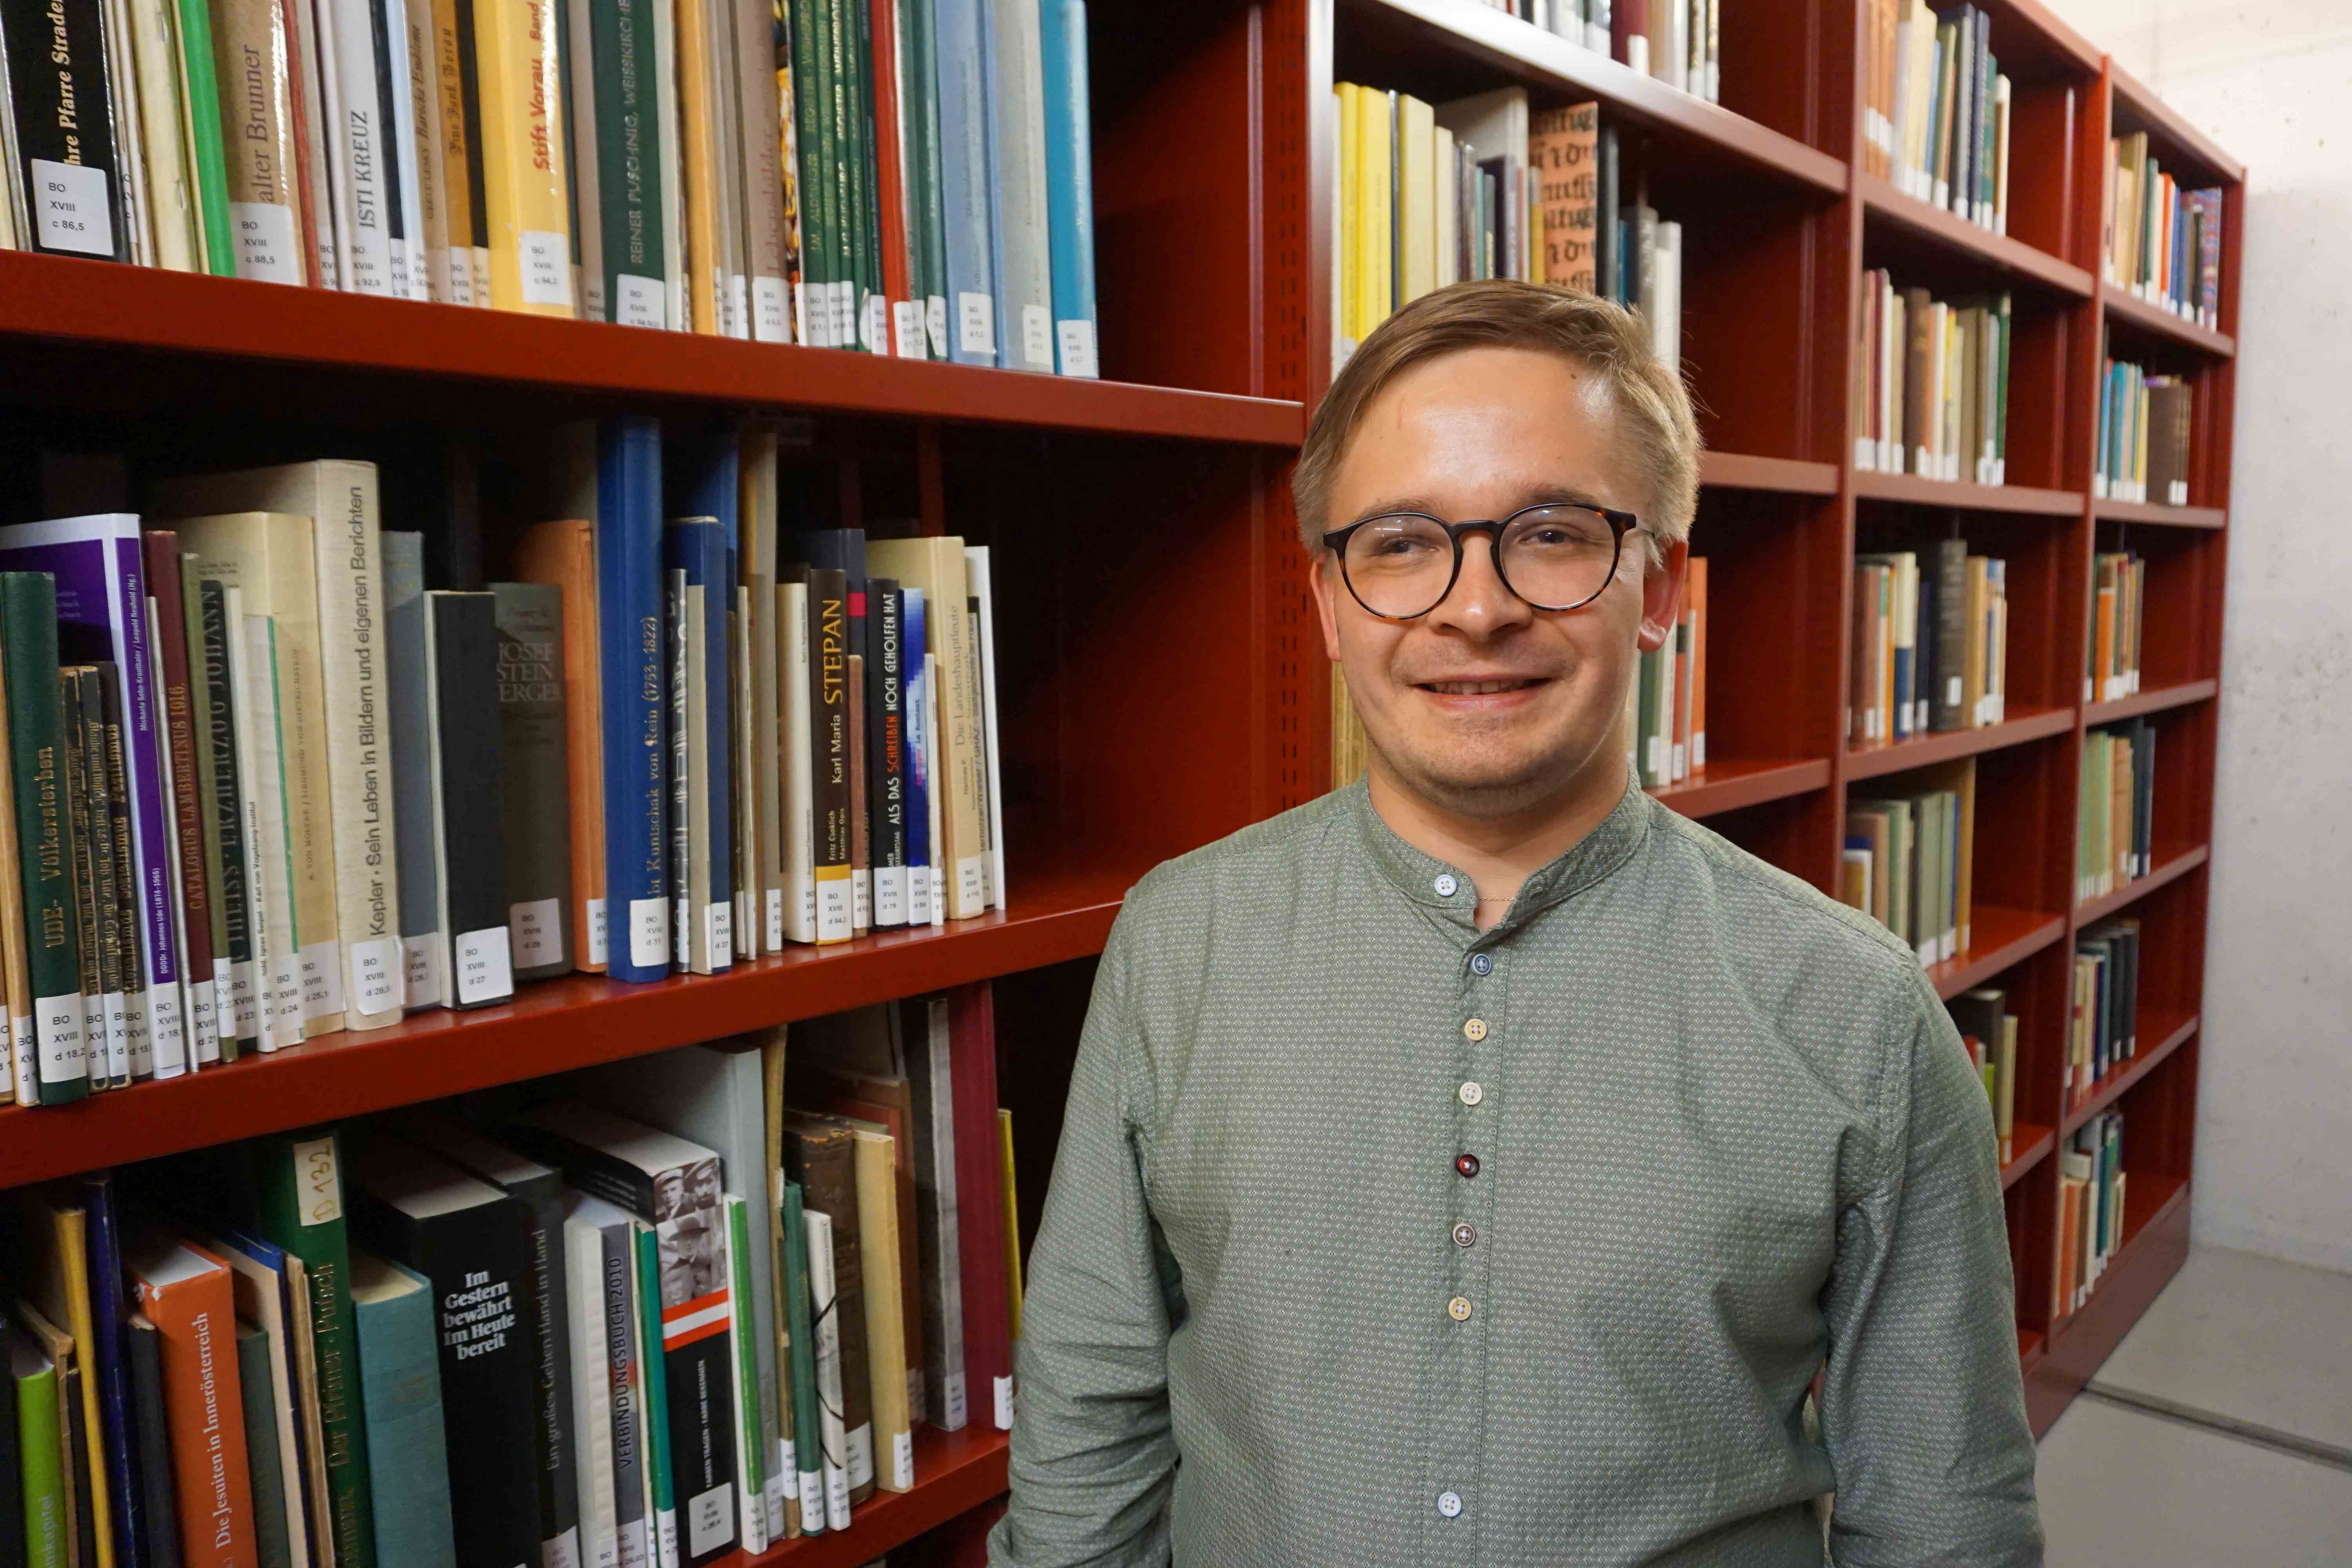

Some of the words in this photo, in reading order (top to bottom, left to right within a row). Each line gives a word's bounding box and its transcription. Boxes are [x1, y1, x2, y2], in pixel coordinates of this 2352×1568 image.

[46, 0, 69, 65] Strade
[527, 1, 541, 41] Band
[59, 71, 79, 130] Pfarre
[244, 45, 268, 143] Brunner
[528, 58, 546, 116] Vorau
[350, 111, 373, 183] KREUZ
[530, 123, 550, 171] Stift
[49, 182, 66, 192] BO
[50, 200, 76, 212] XVIII
[61, 220, 85, 231] 86,5
[242, 221, 258, 230] BO
[628, 210, 643, 264] REINER
[244, 238, 267, 247] XVIII
[532, 245, 545, 254] BO
[353, 262, 373, 270] XVIII
[629, 304, 647, 312] XVIII
[348, 486, 365, 571] Berichten
[129, 591, 138, 618] Neuhold
[354, 575, 371, 643] eigenen
[882, 593, 895, 615] HAT
[132, 621, 141, 644] Leopold
[201, 590, 224, 688] JOHANN
[883, 619, 896, 672] GEHOLFEN
[352, 648, 371, 681] und
[497, 642, 553, 663] JOSEF
[822, 599, 842, 705] STEPAN
[950, 604, 964, 722] Landeshauptleute
[134, 651, 146, 702] Sohn-Kronthaler
[496, 663, 554, 682] STEIN
[885, 677, 897, 712] NOCH
[139, 703, 149, 731] Michaela
[353, 684, 375, 745] Bildern
[831, 714, 841, 751] Maria
[886, 715, 900, 772] SCHREIBEN
[954, 726, 965, 748] Die
[360, 749, 376, 764] in
[650, 753, 659, 780] von
[831, 753, 842, 784] Karl
[171, 720, 196, 823] LAMBERTINUS
[362, 767, 380, 822] Leben
[887, 777, 899, 800] DAS
[887, 804, 900, 825] ALS
[250, 801, 261, 868] Vogelsang-Institut
[646, 788, 661, 871] Kuntschak
[365, 825, 381, 867] Sein
[181, 828, 201, 910] CATALOGUS
[370, 878, 386, 936] Kepler
[158, 917, 167, 953] Johannes
[363, 957, 377, 967] BO
[465, 948, 477, 956] BO
[277, 974, 289, 983] BO
[302, 962, 314, 971] BO
[365, 972, 385, 981] XVIII
[466, 961, 485, 971] XVIII
[476, 975, 485, 984] 27
[232, 981, 246, 990] BO
[279, 988, 298, 999] XVIII
[303, 976, 321, 987] XVIII
[156, 1002, 171, 1012] BO
[195, 1004, 209, 1013] BO
[233, 995, 254, 1006] XVIII
[288, 1004, 298, 1013] 24
[53, 1015, 70, 1025] BO
[86, 1014, 102, 1024] BO
[126, 1012, 142, 1021] BO
[158, 1015, 179, 1025] XVIII
[196, 1018, 217, 1029] XVIII
[54, 1031, 78, 1043] XVIII
[531, 1228, 548, 1272] Hand
[465, 1270, 490, 1289] Im
[535, 1274, 549, 1291] in
[608, 1257, 623, 1298] 2010
[313, 1263, 339, 1334] Putsch
[444, 1280, 509, 1309] Gestern
[442, 1295, 512, 1328] bewährt
[535, 1292, 551, 1336] Hand
[443, 1329, 468, 1346] Im
[470, 1313, 516, 1340] Heute
[456, 1332, 507, 1360] bereit
[191, 1312, 220, 1435] Innerösterreich
[610, 1301, 632, 1470] VERBINDUNGSBUCH
[697, 1359, 707, 1400] BEKENNEN
[700, 1399, 709, 1425] FARBE
[208, 1438, 221, 1453] in
[326, 1432, 350, 1468] Der
[702, 1428, 711, 1459] TRAGEN
[211, 1453, 232, 1519] Jesuiten
[216, 1523, 231, 1549] Die
[600, 1552, 612, 1561] BO
